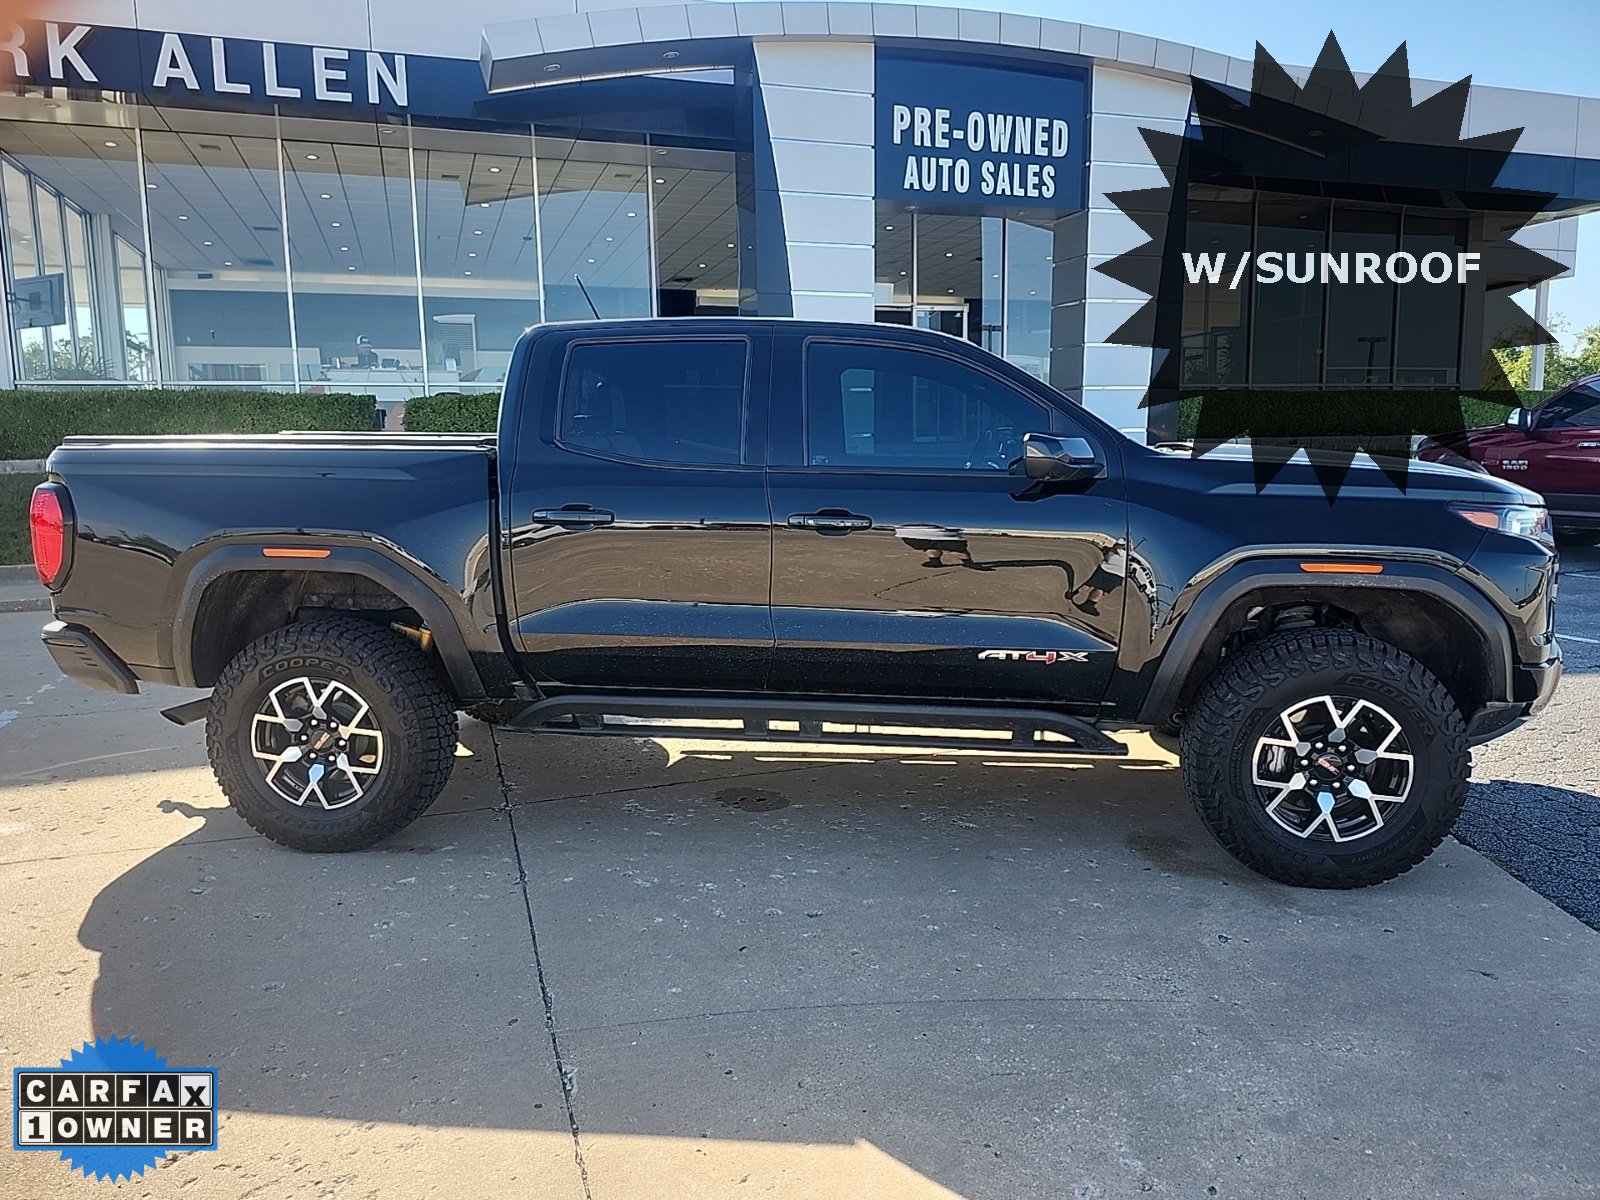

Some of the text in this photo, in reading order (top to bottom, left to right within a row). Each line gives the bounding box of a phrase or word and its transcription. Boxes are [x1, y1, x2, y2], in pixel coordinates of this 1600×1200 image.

[152, 33, 408, 107] ALLEN
[893, 104, 1069, 157] PRE-OWNED
[903, 155, 1055, 198] AUTO SALES
[262, 657, 350, 677] COOPER
[977, 649, 1089, 664] AT4X
[1345, 676, 1433, 736] COOPER
